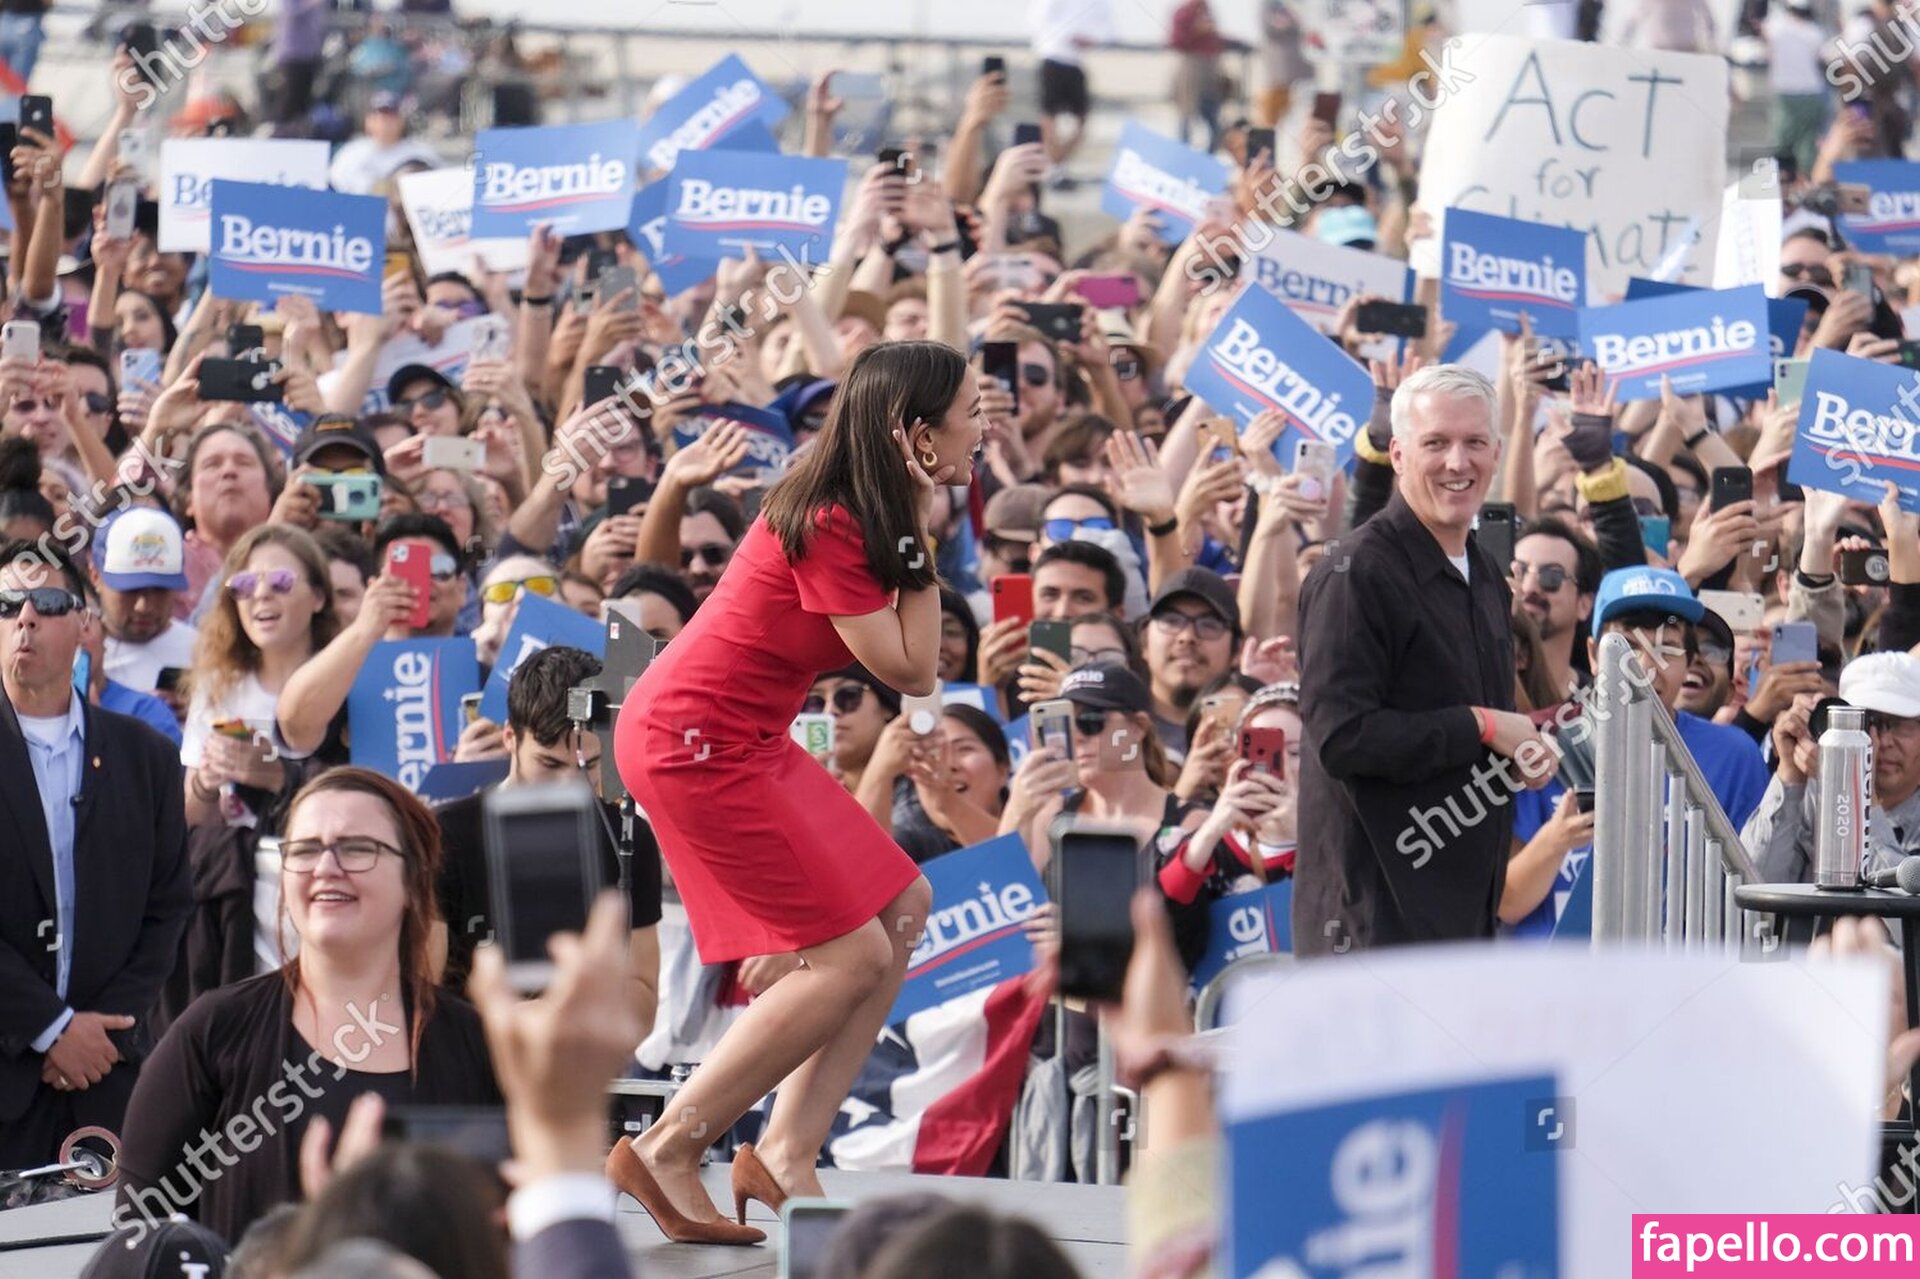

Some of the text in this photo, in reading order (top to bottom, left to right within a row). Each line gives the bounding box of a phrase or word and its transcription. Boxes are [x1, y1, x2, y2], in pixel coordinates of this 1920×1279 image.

[481, 151, 628, 201] Bernie
[676, 177, 832, 226] Bernie
[1534, 158, 1602, 200] for
[218, 213, 375, 273] Bernie
[1446, 240, 1579, 301] Bernie
[1592, 314, 1757, 373] Bernie
[1213, 317, 1357, 446] Bernie
[382, 651, 438, 794] ernie
[1836, 794, 1851, 838] 2020
